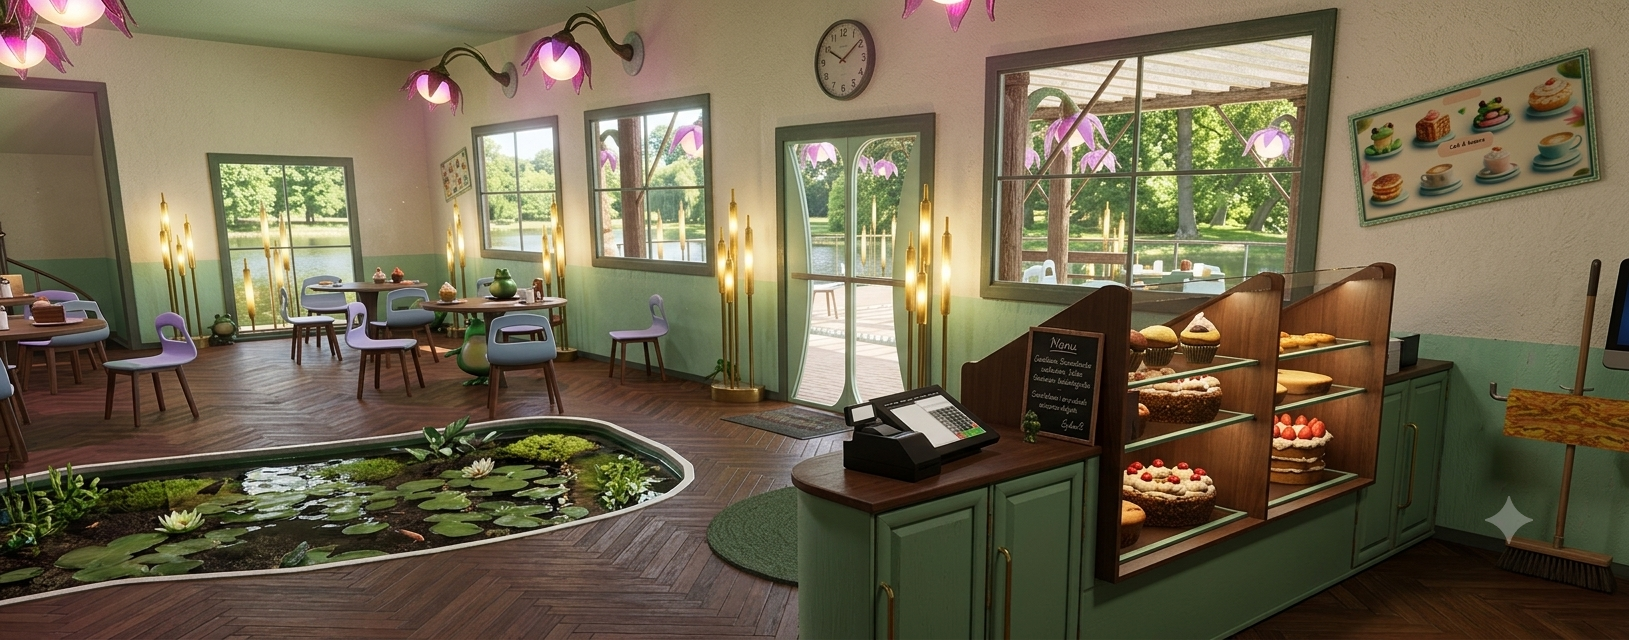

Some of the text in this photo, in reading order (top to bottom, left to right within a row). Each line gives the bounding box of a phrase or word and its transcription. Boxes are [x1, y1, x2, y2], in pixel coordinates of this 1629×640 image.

[840, 28, 848, 37] 12
[831, 34, 837, 43] 11
[858, 39, 864, 48] 2
[861, 53, 866, 62] 3
[821, 59, 826, 67] 9
[858, 67, 863, 76] 4
[824, 73, 829, 81] 8
[851, 79, 856, 87] 5
[841, 84, 846, 92] 6
